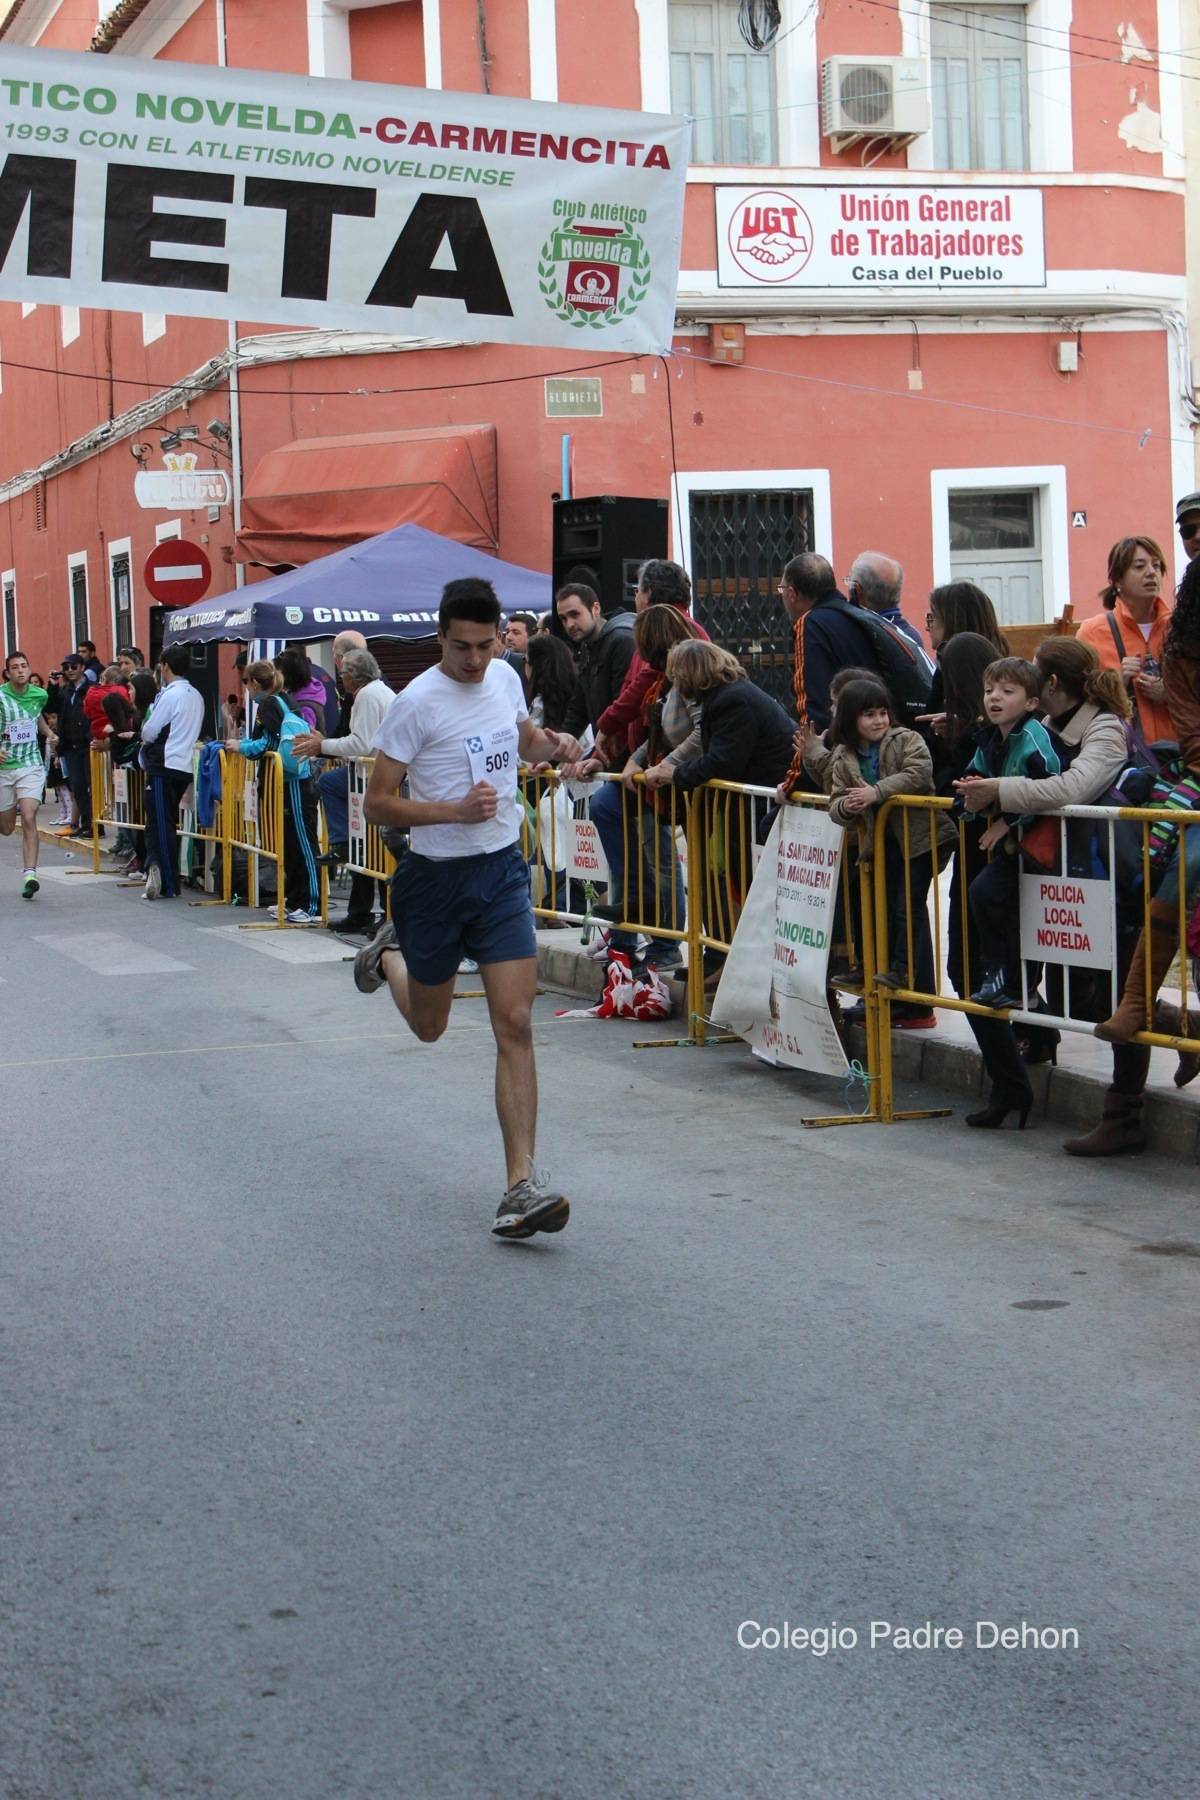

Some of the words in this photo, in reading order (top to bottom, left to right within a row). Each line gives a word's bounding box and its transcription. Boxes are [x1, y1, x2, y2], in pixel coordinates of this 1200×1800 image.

[136, 93, 671, 170] NOVELDA-CARMENCITA
[5, 122, 69, 143] 1993
[78, 129, 138, 151] CON
[146, 136, 178, 154] EL
[187, 140, 335, 170] ATLETISMO
[342, 155, 515, 187] NOVELDENSE
[553, 199, 586, 218] Club
[590, 202, 647, 224] Atlético
[840, 193, 910, 222] Unión
[918, 193, 1011, 222] General
[742, 206, 798, 237] UGT
[561, 238, 633, 264] Novelda
[830, 229, 860, 257] de
[867, 229, 1024, 260] Trabajadores
[851, 265, 899, 281] Casa
[906, 265, 934, 281] del
[940, 265, 1003, 281] Pueblo
[1072, 511, 1086, 528] A
[312, 607, 380, 623] Club
[17, 732, 30, 740] 804
[485, 750, 509, 773] 509
[575, 824, 597, 837] POLICIA
[577, 840, 595, 854] LOCAL
[574, 856, 599, 870] NOVELDA
[1040, 884, 1085, 904] POLICIA
[1044, 907, 1082, 927] LOCAL
[1037, 928, 1091, 952] NOVELDA
